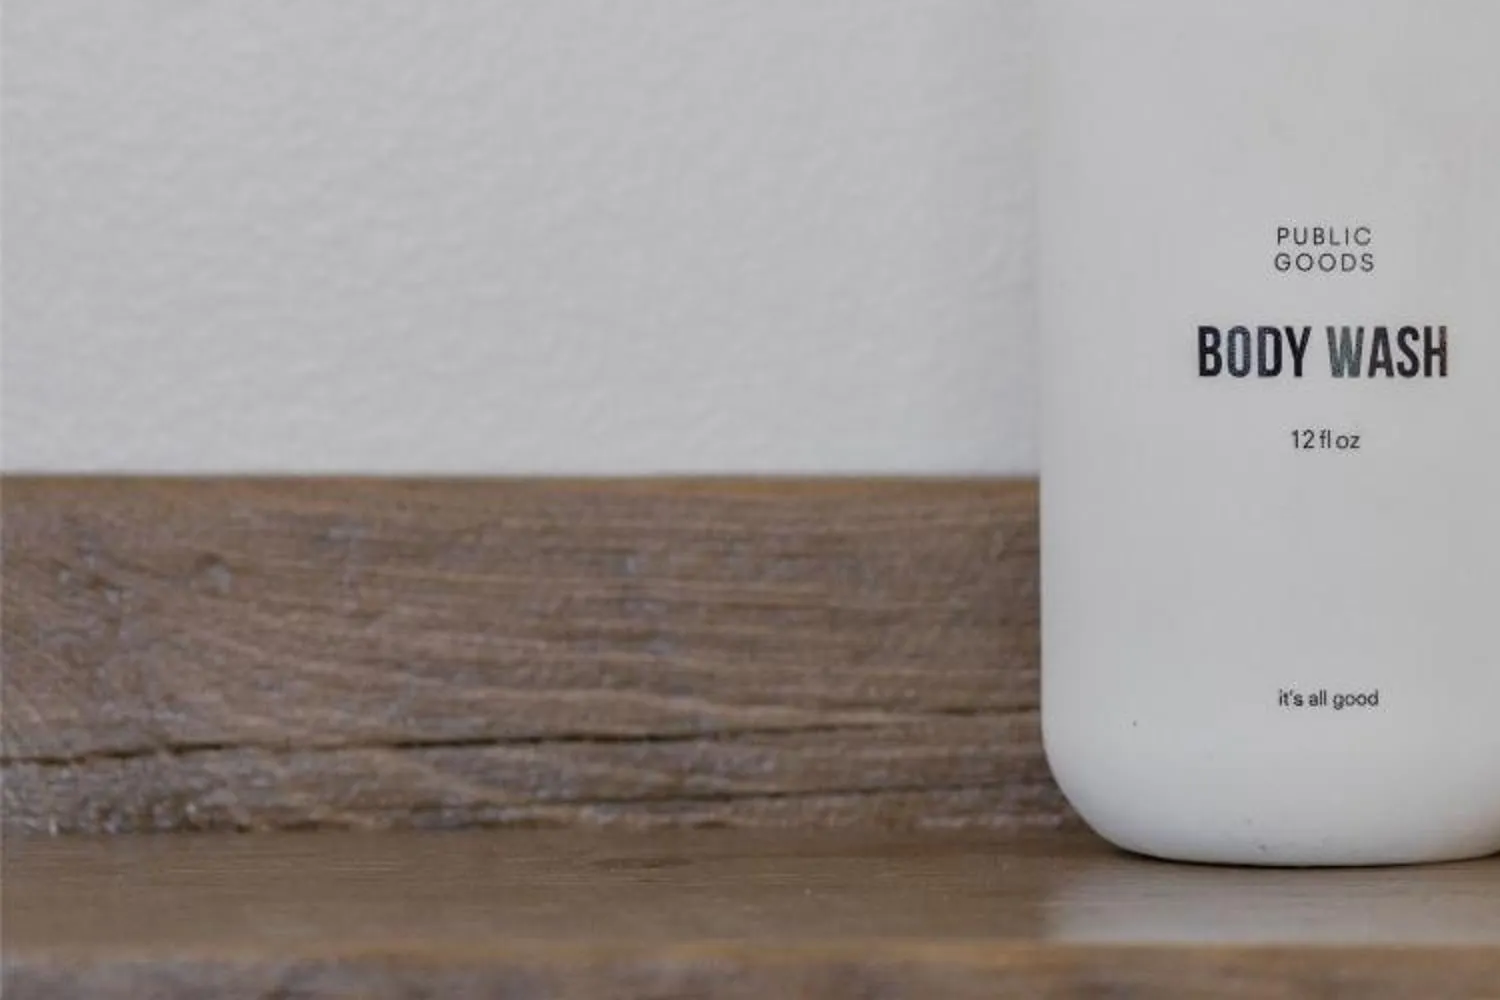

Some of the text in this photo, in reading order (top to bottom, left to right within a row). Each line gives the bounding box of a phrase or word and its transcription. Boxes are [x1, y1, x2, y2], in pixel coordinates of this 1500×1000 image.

[1276, 226, 1372, 246] PUBLIC
[1273, 252, 1375, 273] GOODS
[1197, 325, 1449, 379] BODY WASH
[1291, 429, 1361, 450] 12 fl oz
[1278, 689, 1379, 711] it's all good
